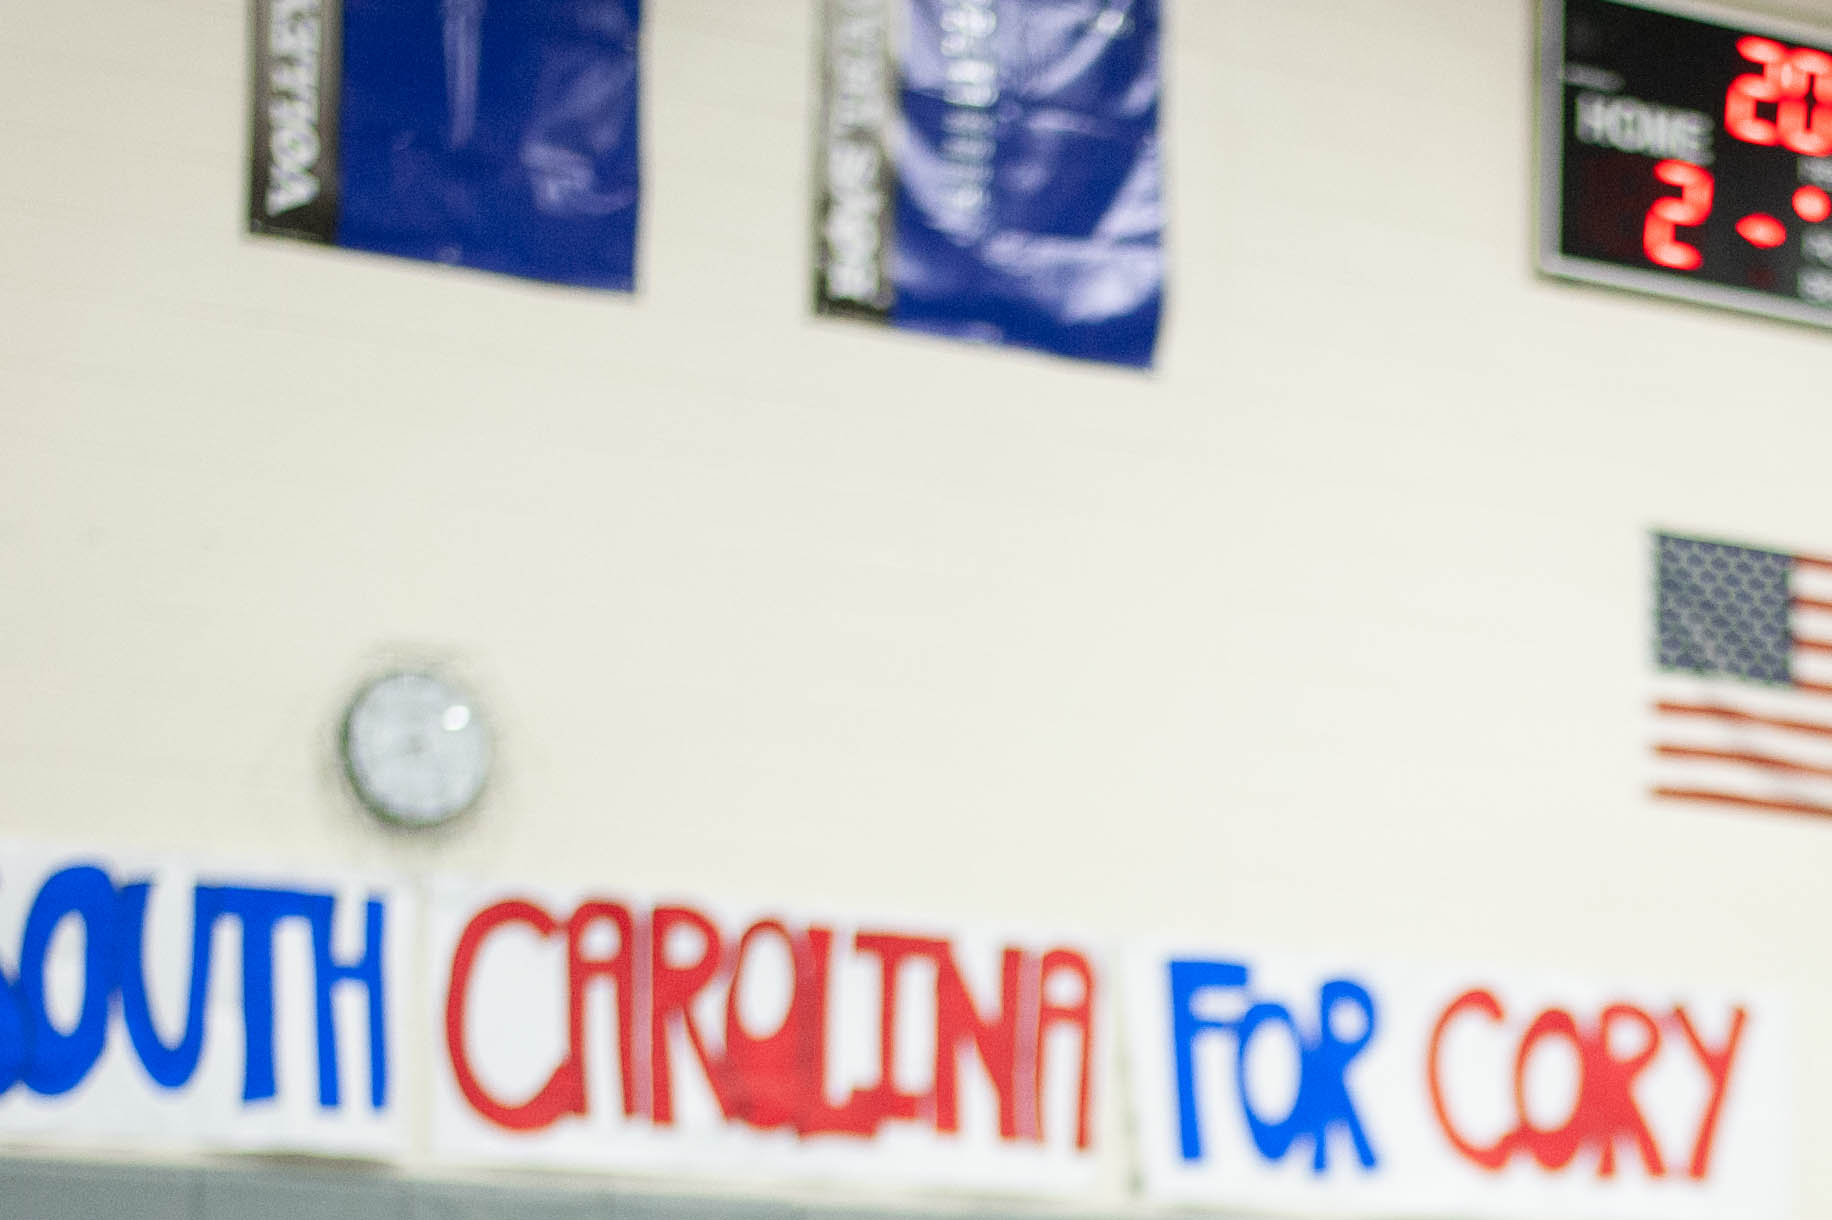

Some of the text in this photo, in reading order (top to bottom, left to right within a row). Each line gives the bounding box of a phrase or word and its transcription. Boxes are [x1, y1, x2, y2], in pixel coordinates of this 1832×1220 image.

[1575, 90, 1716, 166] HOME
[1643, 159, 1715, 271] 2
[445, 897, 1095, 1152] CAROLINA
[1168, 958, 1380, 1176] FOR
[1427, 987, 1747, 1182] CORY
